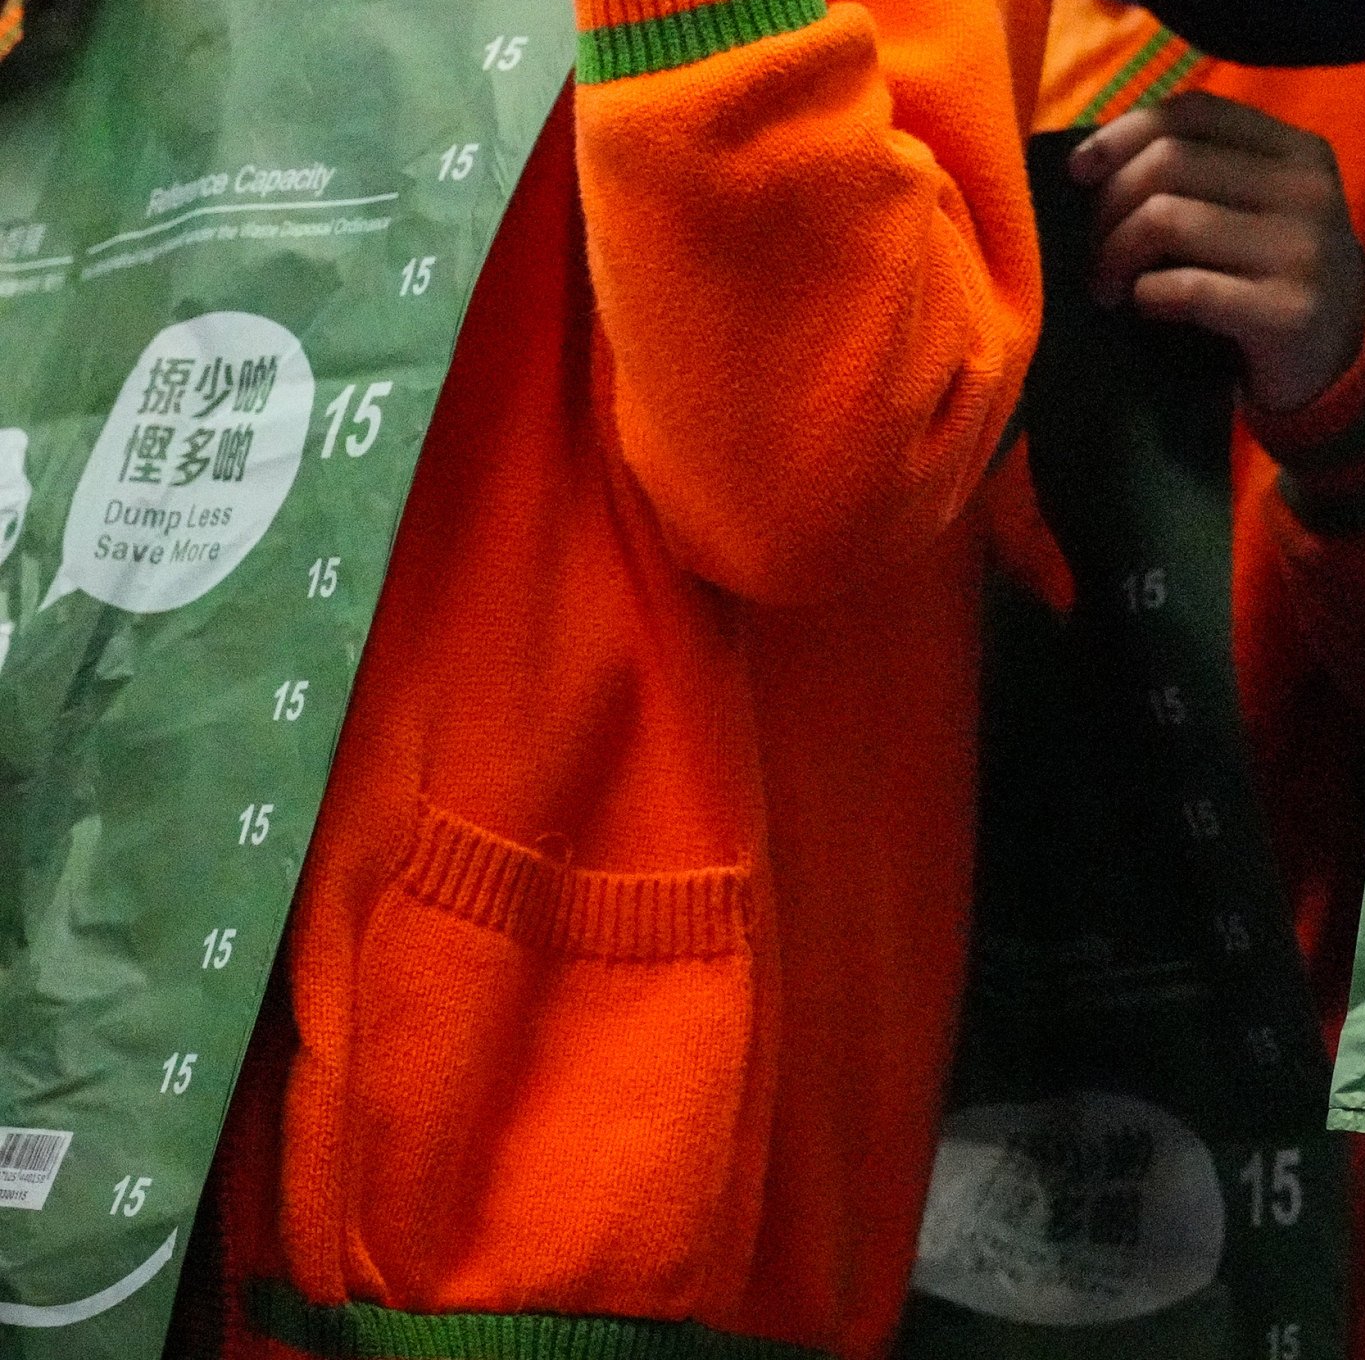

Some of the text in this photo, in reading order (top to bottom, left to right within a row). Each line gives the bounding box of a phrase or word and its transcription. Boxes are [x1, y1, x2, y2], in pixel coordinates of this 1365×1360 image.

[482, 36, 528, 71] 15
[235, 161, 336, 197] Capacity
[438, 143, 479, 181] 15
[400, 256, 436, 297] 15
[321, 381, 393, 459] 15
[118, 423, 254, 487] 慳多啲
[103, 499, 233, 536] Dump Less
[94, 535, 220, 565] Save More
[307, 557, 341, 599] 15
[1121, 567, 1168, 611] 15
[272, 680, 309, 722] 15
[238, 804, 274, 846] 15
[202, 928, 237, 970] 15
[160, 1052, 198, 1094] 15
[110, 1175, 152, 1218] 15
[1241, 1148, 1302, 1226] 15
